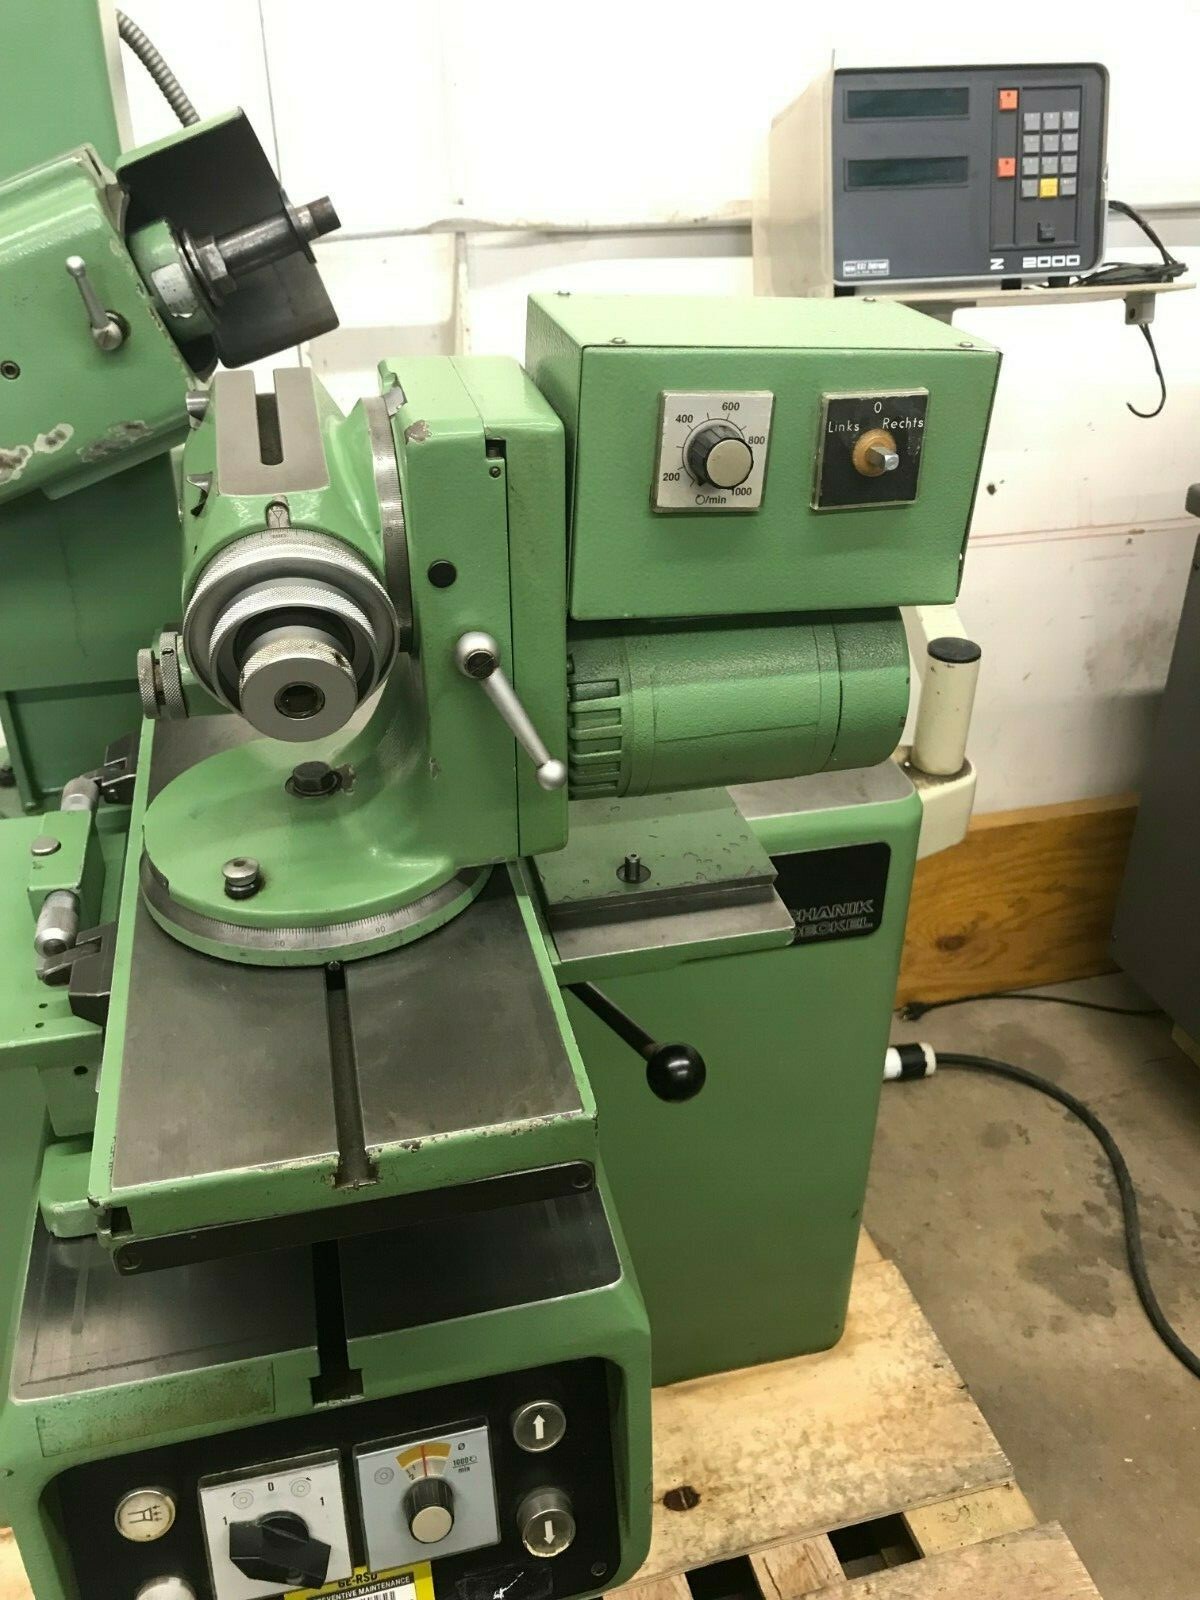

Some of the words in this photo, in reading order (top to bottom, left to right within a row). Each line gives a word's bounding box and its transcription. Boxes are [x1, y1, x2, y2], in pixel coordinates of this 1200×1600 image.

[1022, 254, 1080, 269] 2000
[721, 401, 740, 411] 600
[675, 414, 693, 424] 400
[828, 420, 860, 433] Links
[882, 416, 924, 430] Rechts
[747, 435, 765, 445] 800
[662, 472, 680, 482] 200
[358, 1576, 411, 1595] MAINTENANCE
